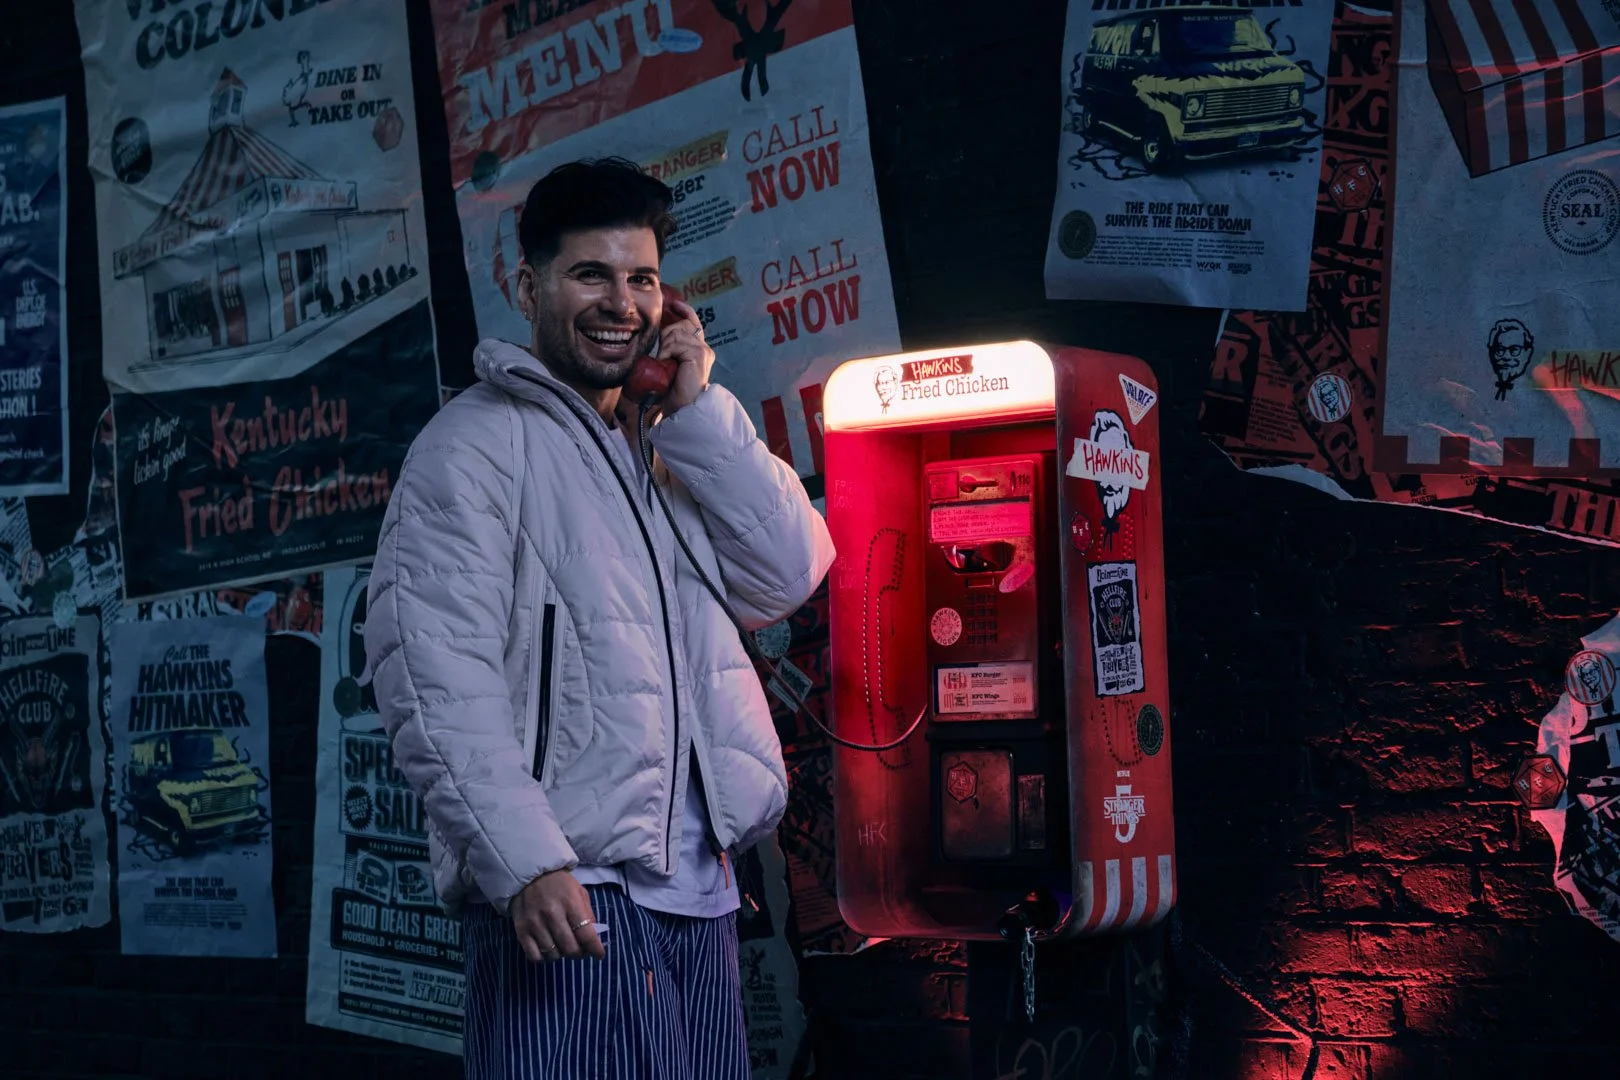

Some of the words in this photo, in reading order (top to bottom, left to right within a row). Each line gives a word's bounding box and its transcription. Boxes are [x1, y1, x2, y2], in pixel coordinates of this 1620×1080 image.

[315, 66, 357, 88] DINE
[362, 63, 391, 81] IN
[460, 0, 678, 131] MENU
[341, 88, 356, 101] OR
[308, 104, 352, 126] TAKE
[357, 98, 395, 120] OUT
[742, 106, 838, 165] CALL
[747, 141, 842, 214] NOW
[1105, 214, 1148, 228] SURVIVE
[1152, 216, 1171, 229] THE
[1125, 201, 1144, 214] THE
[1148, 202, 1173, 214] RIDE
[1176, 203, 1203, 216] THAT
[1207, 204, 1229, 216] CAN
[1560, 203, 1605, 218] SEAL
[761, 239, 859, 297] CALL
[767, 275, 862, 347] NOW
[901, 380, 941, 401] Fried
[945, 374, 1010, 397] Chicken
[210, 384, 350, 470] Kentucky
[178, 476, 255, 553] Fried
[268, 461, 392, 536] Chicken
[189, 644, 209, 660] THE
[138, 660, 234, 694] HAWKINS
[18, 699, 53, 724] CLUB
[128, 692, 250, 732] HITMAKER
[1103, 798, 1145, 816] STRANGER
[1112, 812, 1140, 825] THINGS
[343, 899, 377, 931] GOOD
[380, 907, 421, 939] DEALS
[424, 914, 462, 948] GREAT
[342, 929, 386, 948] HOUSEHOLD
[394, 940, 438, 958] GROCERIES
[446, 949, 465, 963] TOYS
[409, 980, 431, 1001] ASK
[430, 986, 461, 1008] THEM
